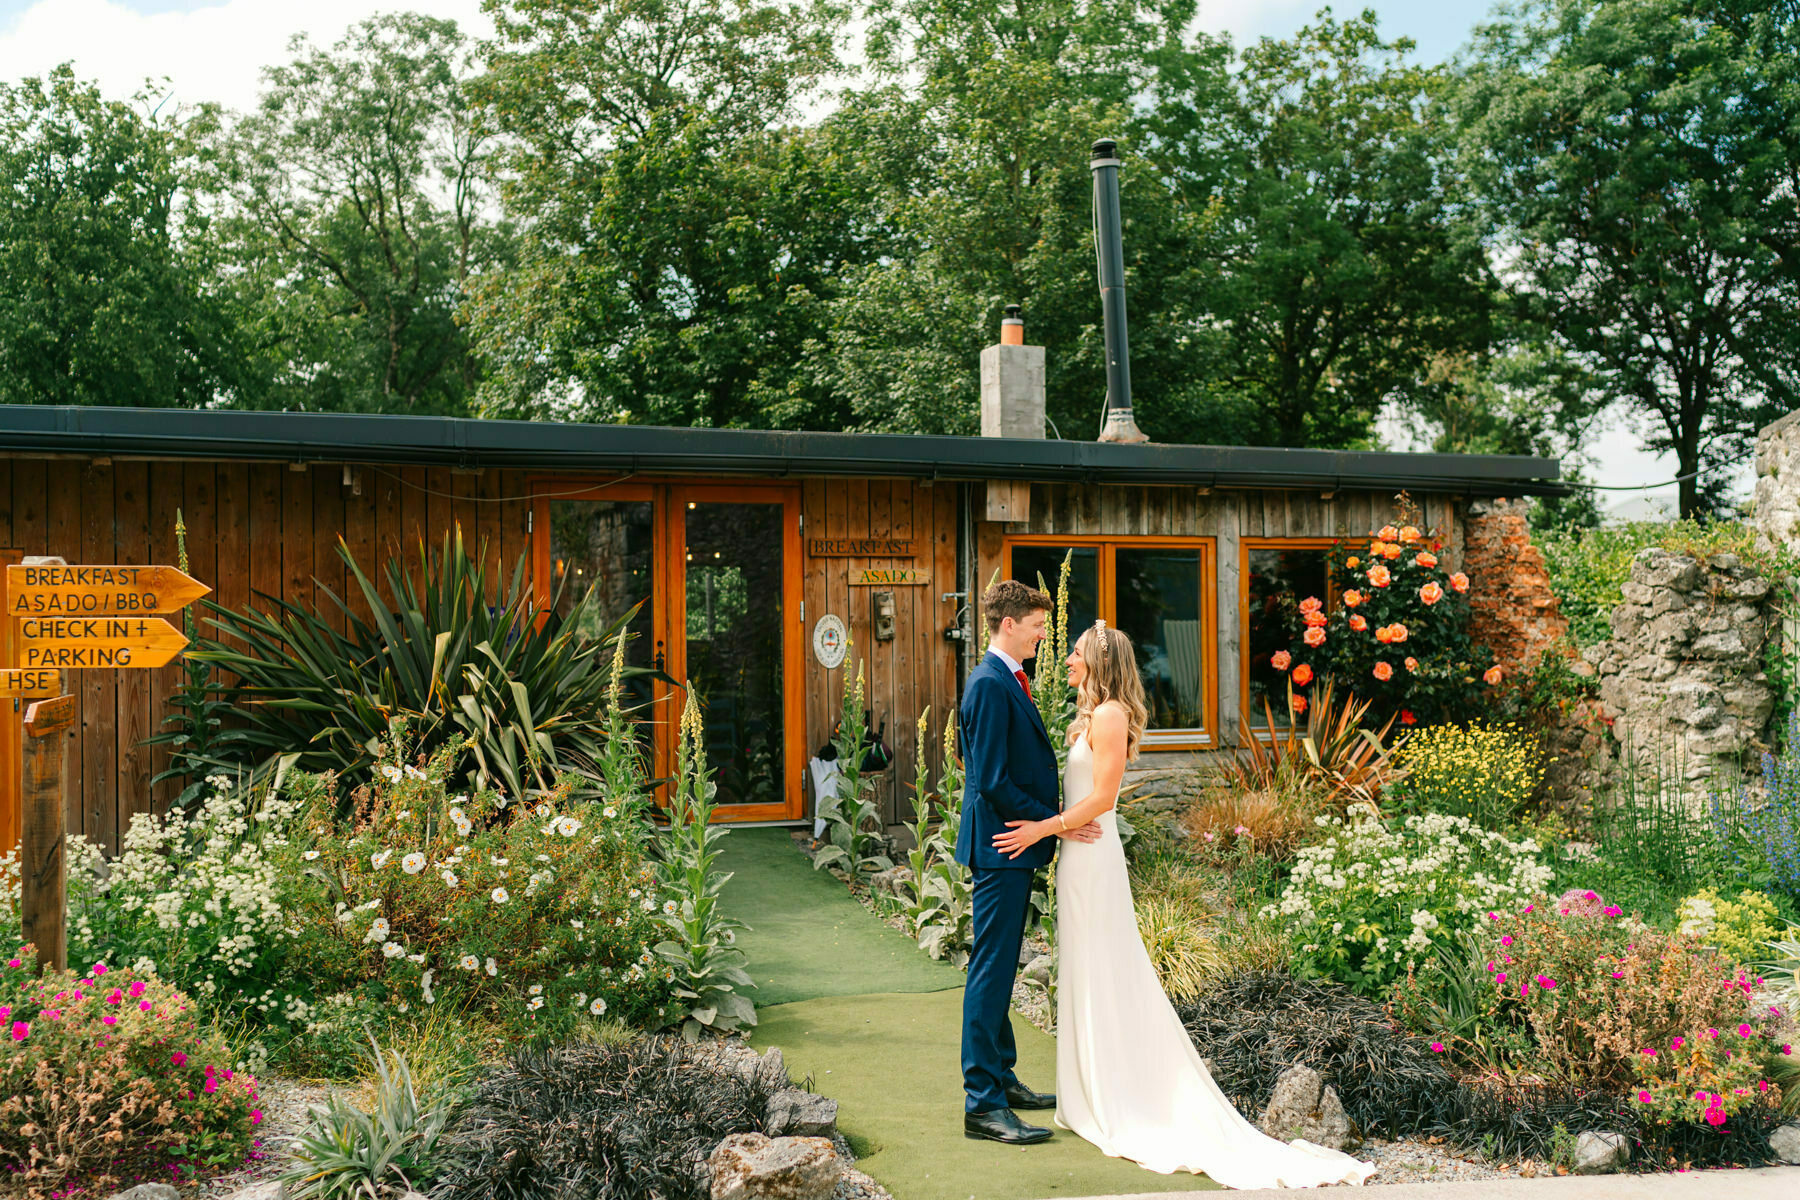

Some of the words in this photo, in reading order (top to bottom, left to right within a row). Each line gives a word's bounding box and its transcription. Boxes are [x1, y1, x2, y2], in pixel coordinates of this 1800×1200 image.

[814, 540, 914, 554] BREAKFAST
[25, 567, 140, 586] BREAKFAST
[860, 569, 916, 583] ASADO
[15, 593, 97, 612] ASADO
[116, 592, 158, 611] BBQ
[23, 620, 98, 639] CHECK
[106, 620, 129, 638] IN
[28, 647, 132, 666] PARKING
[8, 671, 49, 690] HSE
